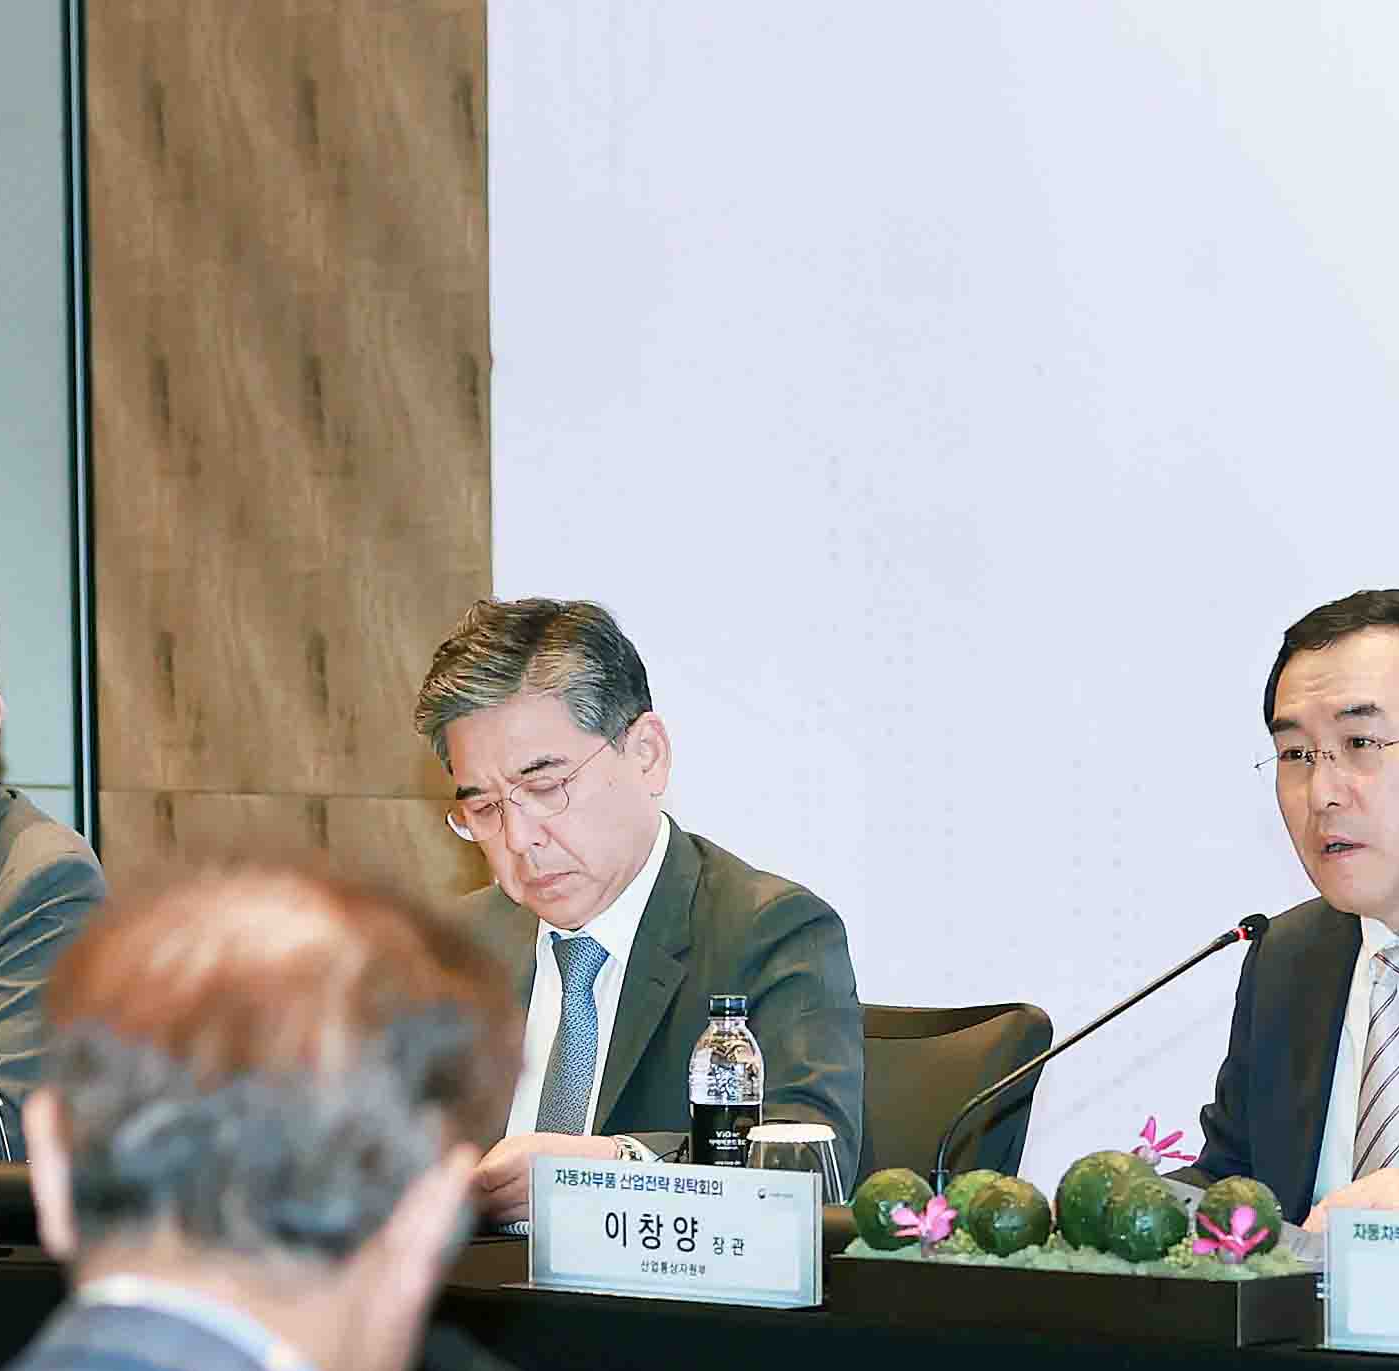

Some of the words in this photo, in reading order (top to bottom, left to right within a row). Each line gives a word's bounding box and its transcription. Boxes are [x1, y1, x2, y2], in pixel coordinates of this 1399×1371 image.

[554, 1167, 617, 1189] 자동차부품
[619, 1172, 670, 1193] 산업전략
[673, 1176, 724, 1197] 원탁회의
[605, 1210, 698, 1253] 이창양
[712, 1235, 745, 1257] 장관
